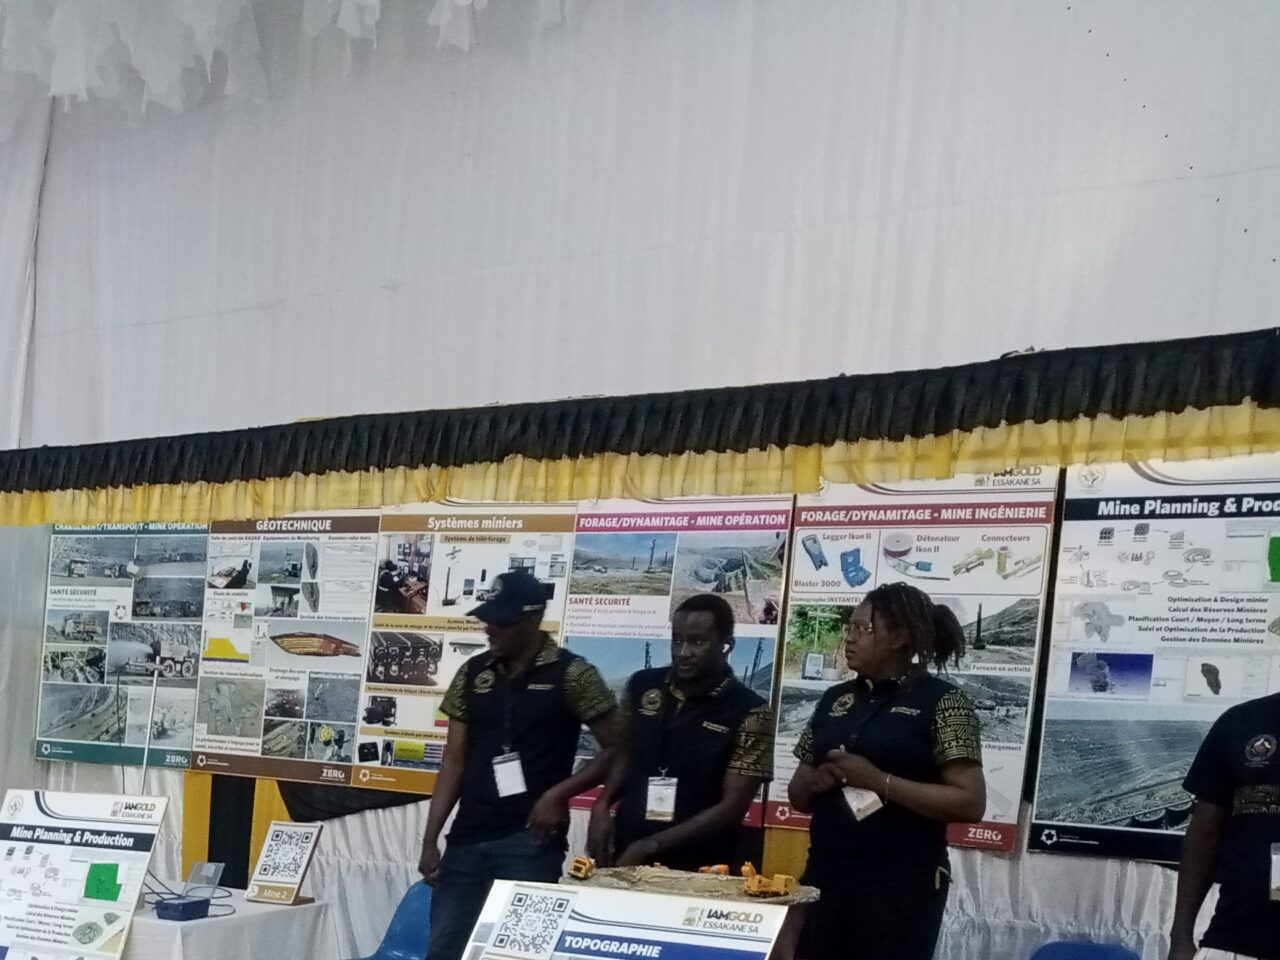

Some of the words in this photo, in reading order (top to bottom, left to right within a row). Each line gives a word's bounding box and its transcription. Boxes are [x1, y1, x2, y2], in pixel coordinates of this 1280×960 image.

[992, 478, 1030, 487] ESSAKANE
[1031, 477, 1041, 486] SA
[1097, 500, 1141, 516] Mine
[1143, 498, 1221, 517] Planning
[1223, 497, 1237, 513] &
[801, 508, 931, 523] FORAGE/DYNAMITAGE
[940, 508, 973, 520] MINE
[975, 504, 1047, 519] INGÉNIERIE
[256, 518, 332, 531] GÉOTECHNIQUE
[427, 516, 479, 530] Systèmes
[481, 516, 523, 528] miniers
[579, 515, 689, 528] FORAGE/DYNAMITAGE
[695, 515, 723, 526] MINE
[725, 512, 786, 526] OPÉRATION
[444, 535, 467, 543] Système
[822, 533, 847, 541] Logger
[916, 534, 960, 542] Détonateur
[981, 534, 1031, 542] Connecteurs
[49, 588, 69, 596] SANTÉ
[70, 588, 97, 596] SÉCURITÉ
[568, 597, 593, 605] SANTÉ
[1167, 596, 1212, 604] Optimisation
[1220, 596, 1245, 604] Design
[1196, 616, 1220, 624] Moyen
[985, 742, 1022, 752] chargement
[322, 768, 345, 778] ZERO
[124, 802, 156, 811] IAMGOLD
[10, 825, 33, 839] Mine
[33, 828, 74, 844] Planning
[73, 830, 82, 843] &
[82, 832, 135, 847] Production
[967, 827, 1003, 841] ZERO
[263, 888, 281, 899] Mine
[281, 890, 288, 899] 2
[706, 908, 764, 924] IAMGOLD
[702, 920, 746, 933] ESSAKANE
[747, 925, 759, 934] SA
[564, 934, 662, 958] TOPOGRAPHIE
